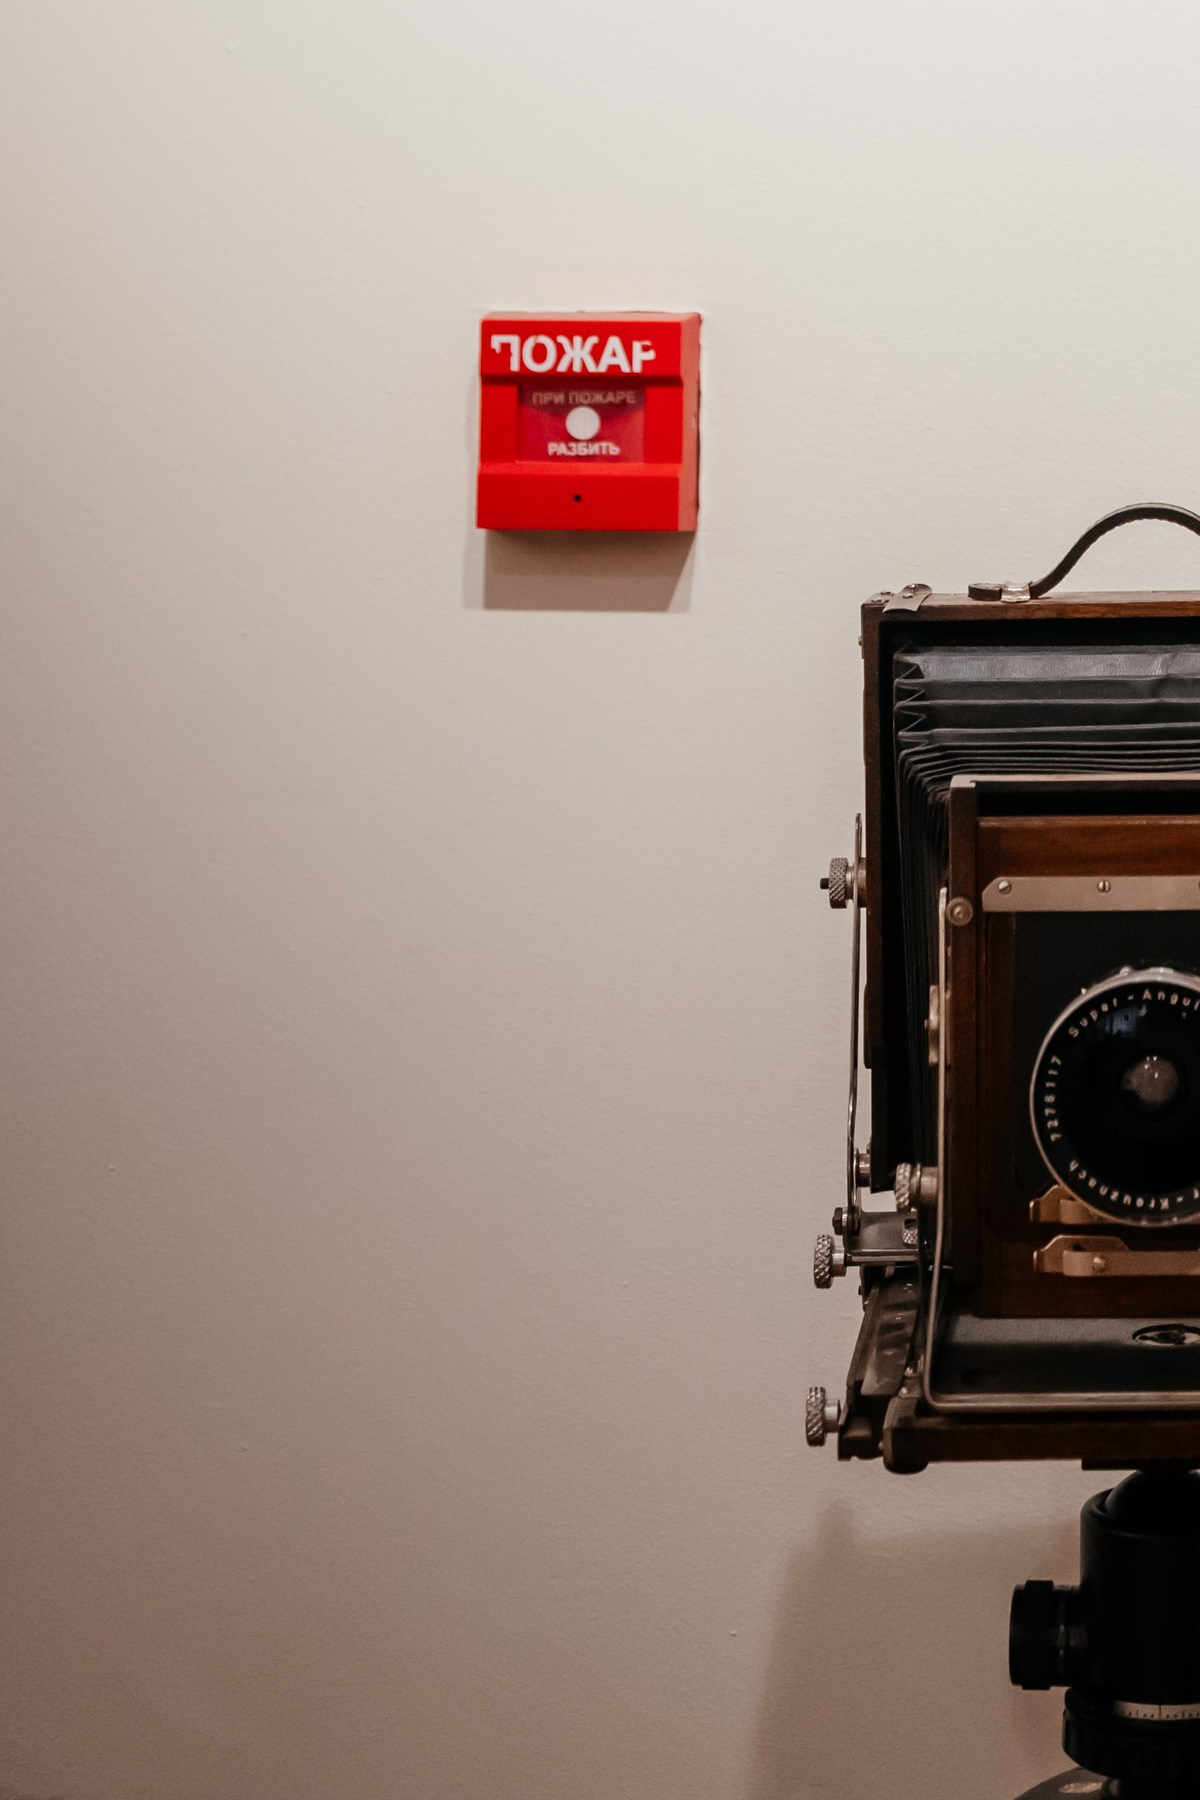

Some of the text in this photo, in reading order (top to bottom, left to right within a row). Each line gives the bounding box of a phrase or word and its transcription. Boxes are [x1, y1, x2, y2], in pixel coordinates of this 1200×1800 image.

[491, 334, 656, 373] ПОЖАР
[533, 391, 636, 405] ПРИ ПОЖАРЕ
[547, 442, 621, 456] РАЗБИТЬ
[1044, 1055, 1062, 1142] 7278117
